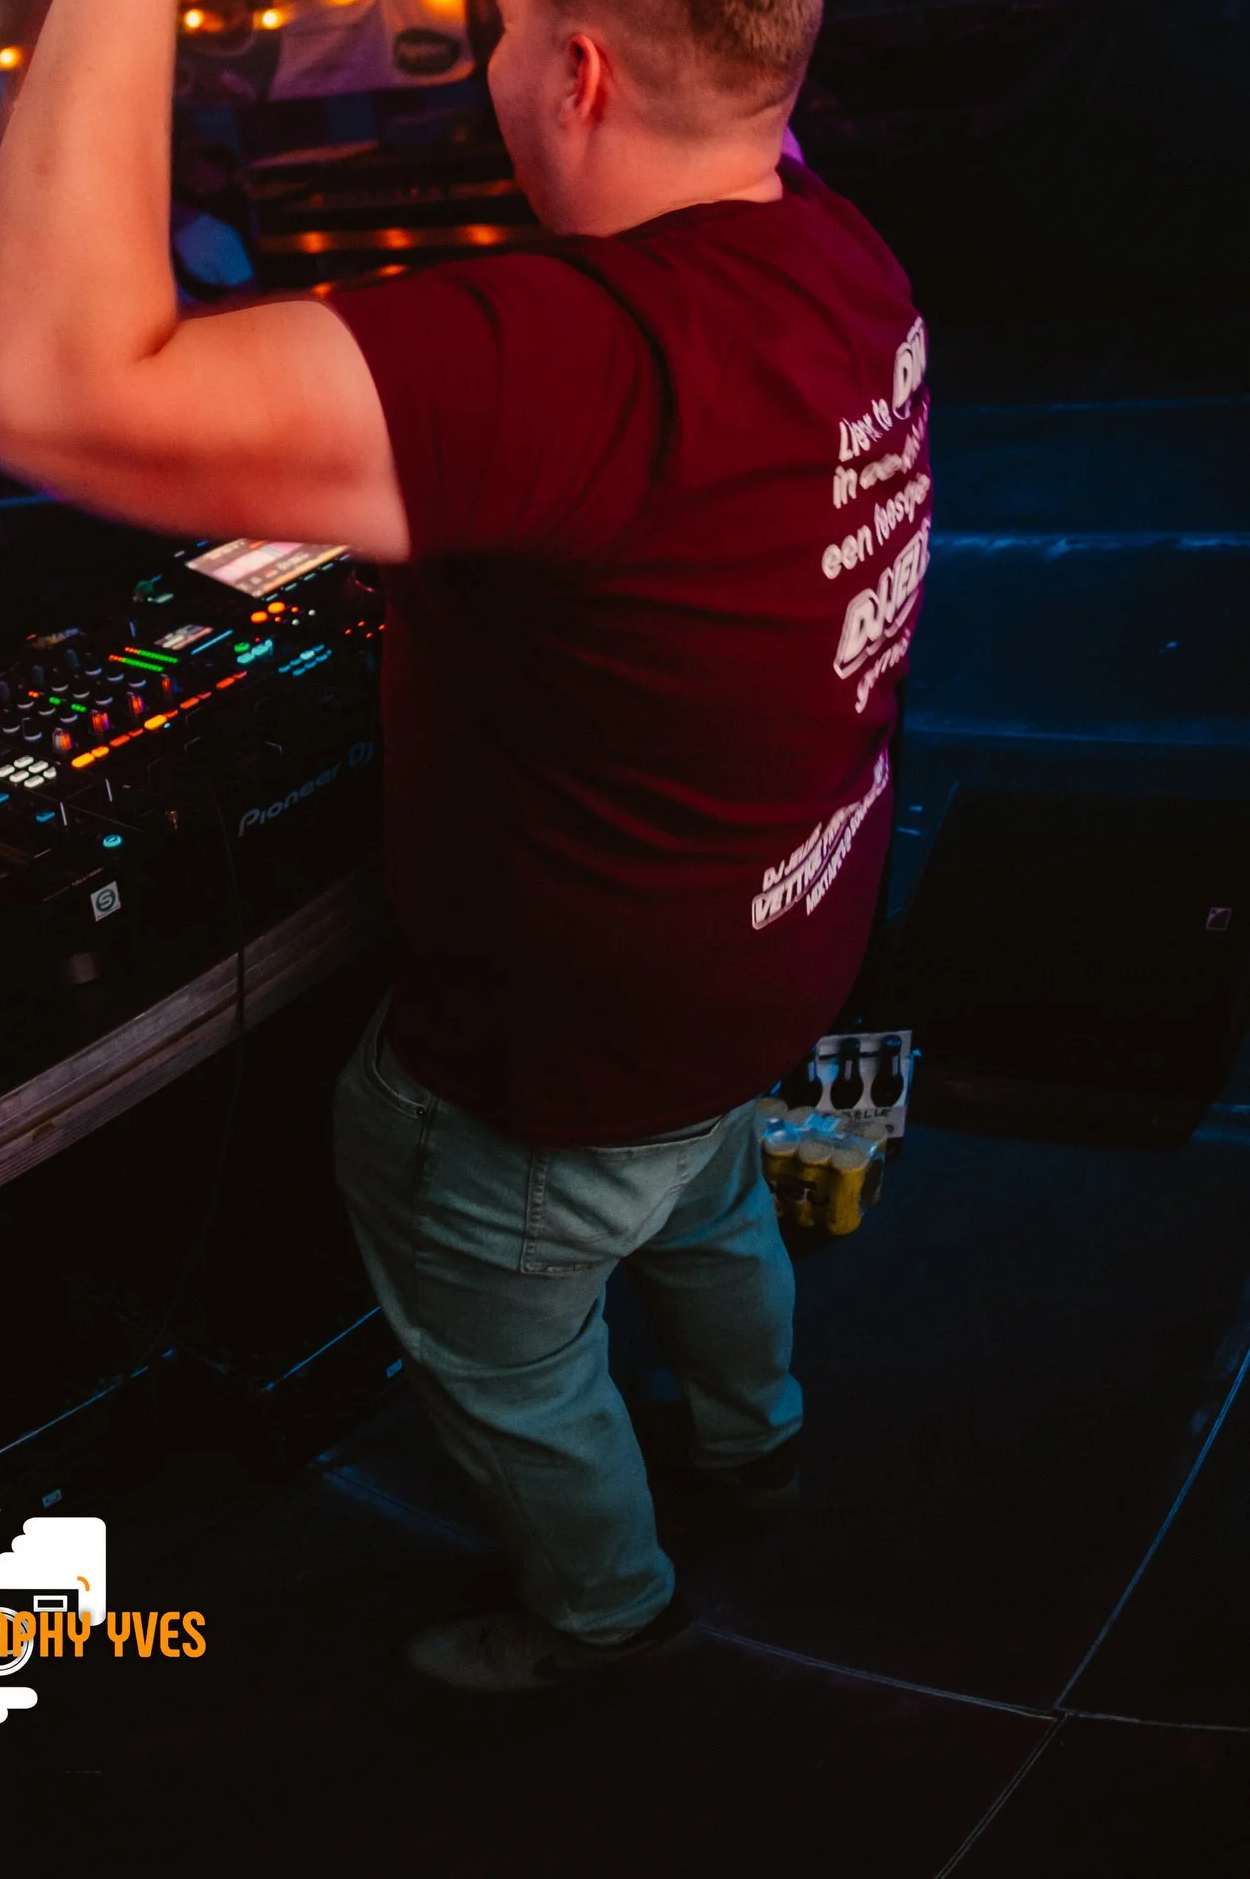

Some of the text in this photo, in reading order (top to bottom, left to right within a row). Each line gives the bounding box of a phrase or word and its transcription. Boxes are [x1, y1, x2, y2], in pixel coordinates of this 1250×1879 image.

[832, 465, 858, 510] in
[821, 524, 874, 580] een
[238, 740, 376, 839] Pioneer DJ
